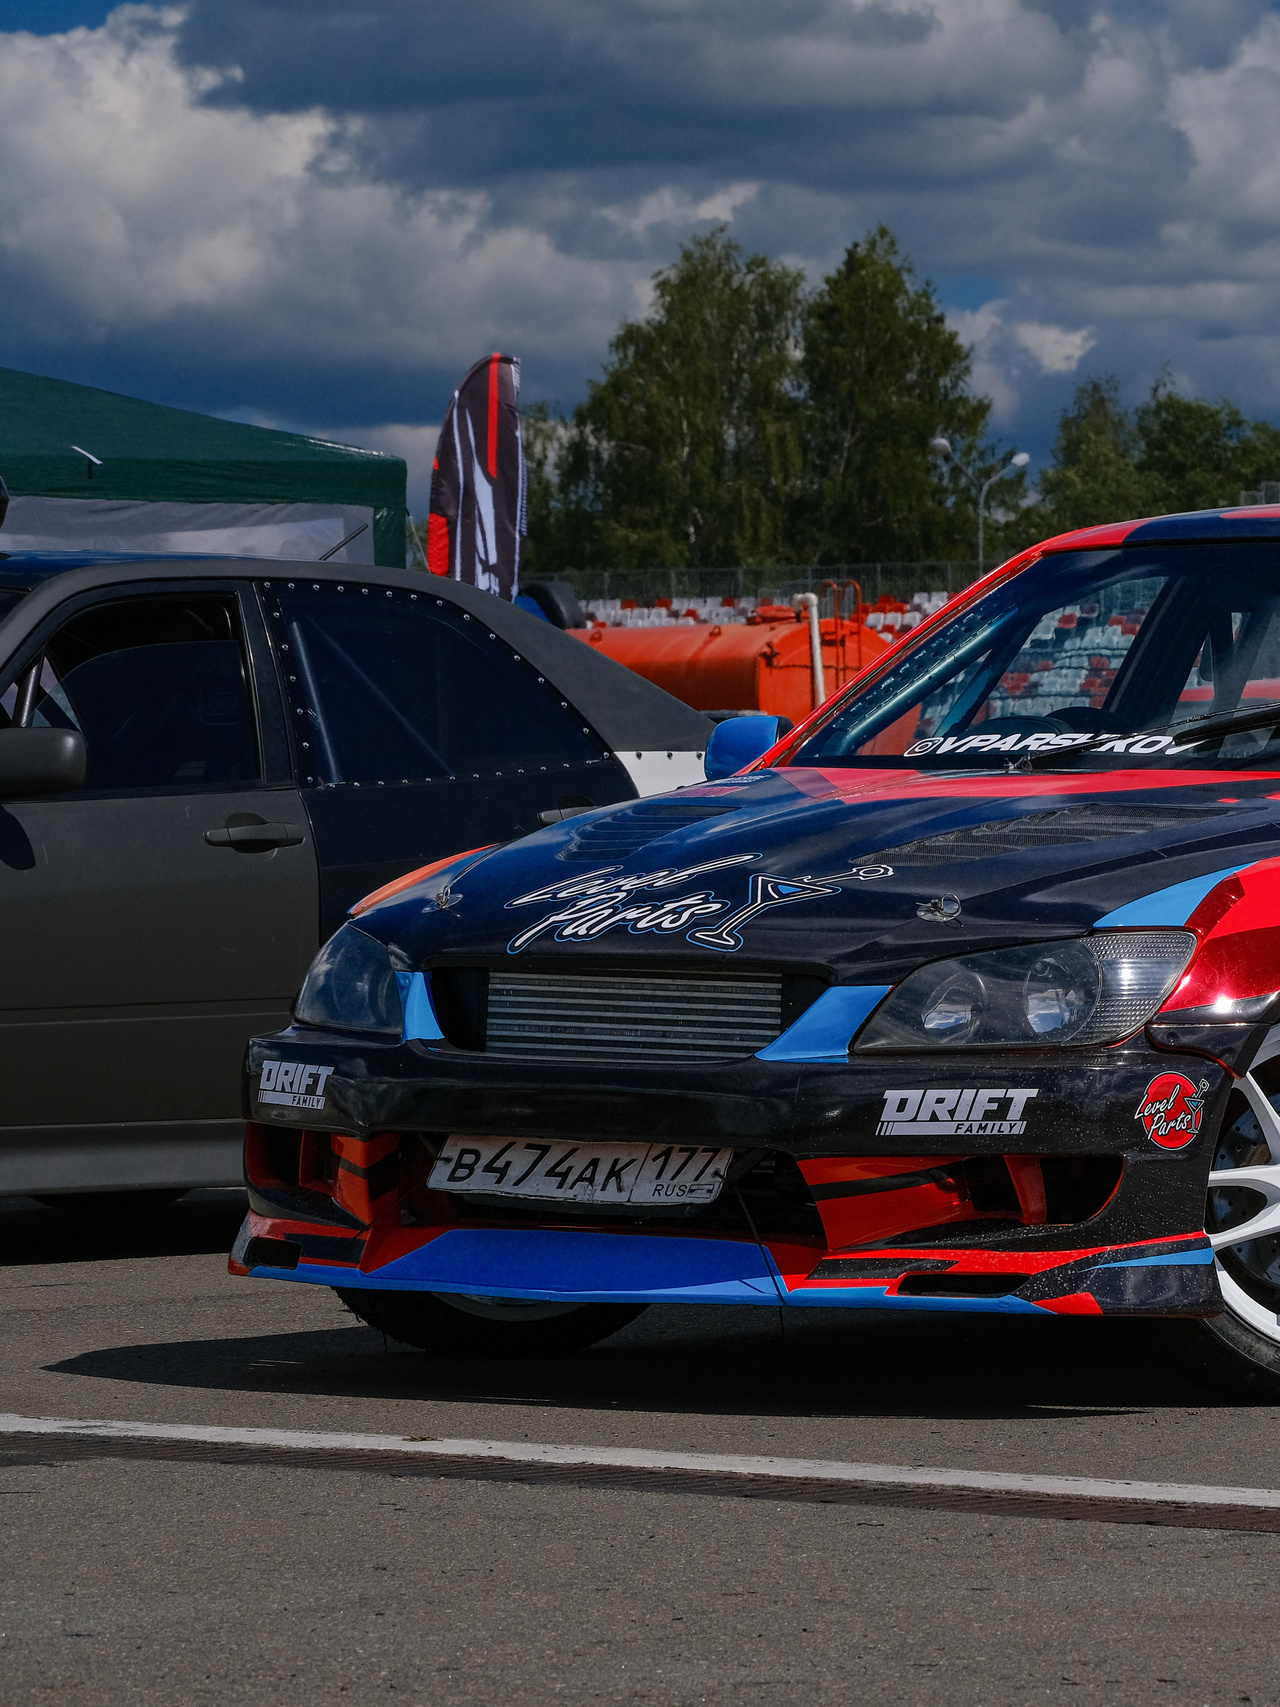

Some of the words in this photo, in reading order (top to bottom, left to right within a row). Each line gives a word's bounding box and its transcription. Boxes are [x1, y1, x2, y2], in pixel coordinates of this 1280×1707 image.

[507, 853, 761, 906] Level
[512, 890, 726, 949] Parts
[260, 1060, 335, 1095] DRIFT
[292, 1095, 321, 1107] FAMILY
[880, 1089, 1039, 1121] DRIFT
[1134, 1084, 1180, 1119] Level
[954, 1123, 1017, 1134] FAMILY
[1147, 1111, 1191, 1140] Parts
[651, 1147, 715, 1182] 177
[652, 1183, 687, 1198] RUS
